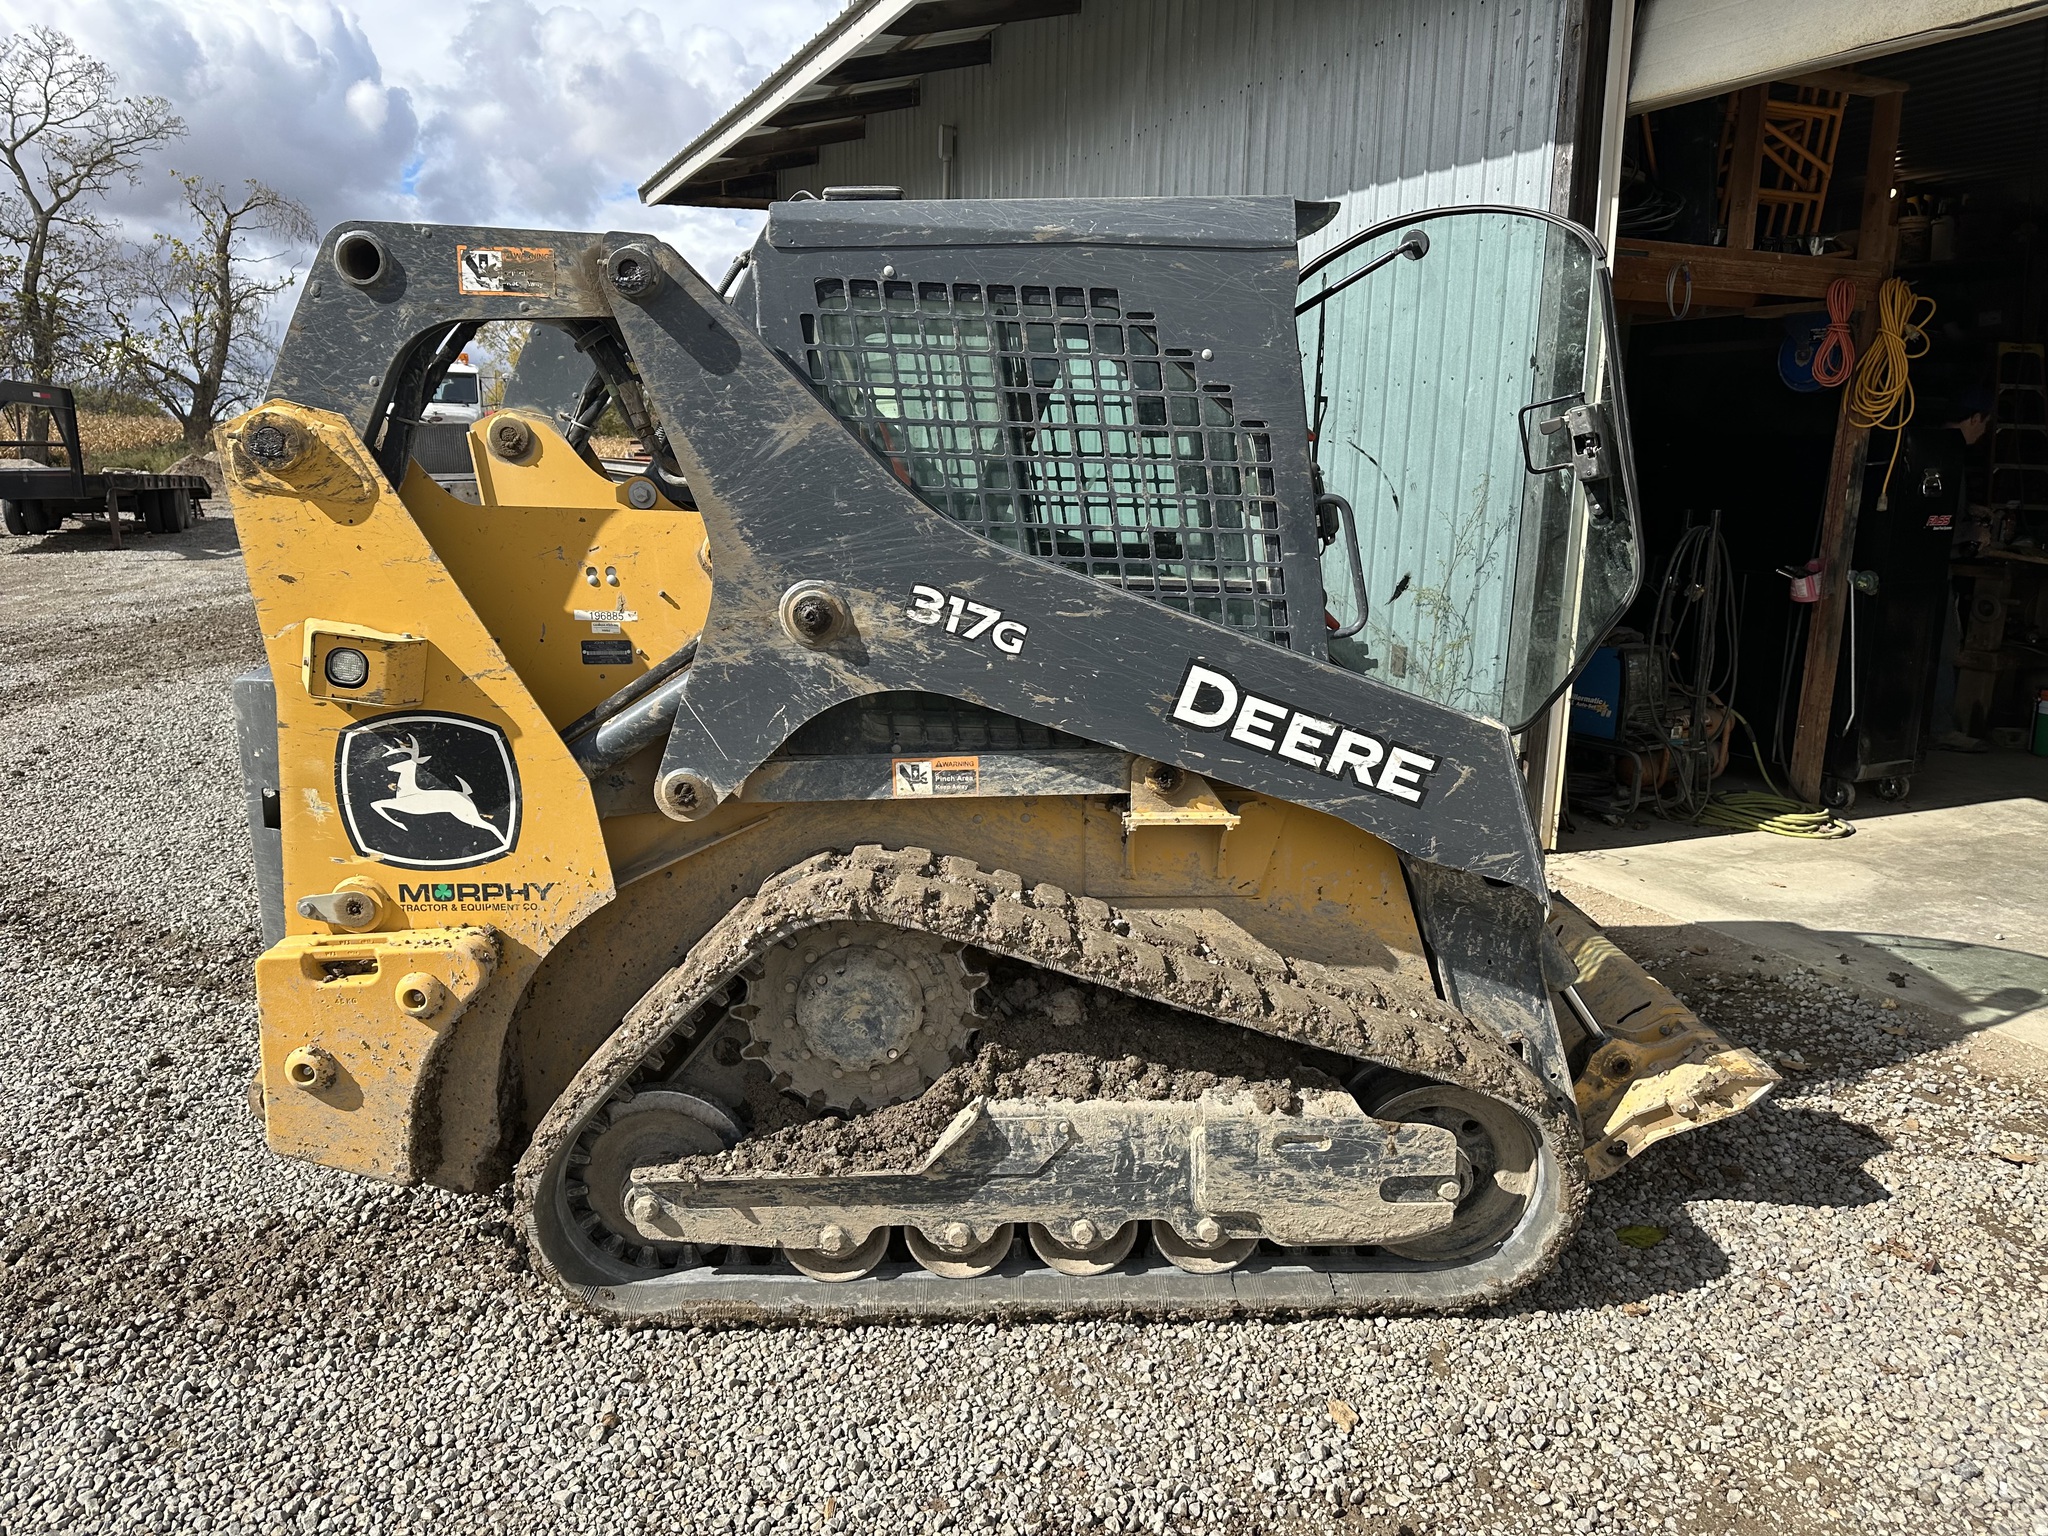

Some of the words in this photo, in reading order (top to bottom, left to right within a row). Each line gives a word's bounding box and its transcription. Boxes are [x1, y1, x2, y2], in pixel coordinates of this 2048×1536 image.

[589, 611, 624, 621] 196885
[906, 585, 1028, 654] 317G
[1173, 665, 1436, 803] DEERE
[398, 883, 555, 902] MURPHY
[401, 904, 448, 912] TRACTOR
[464, 903, 519, 912] EQUIPMENT
